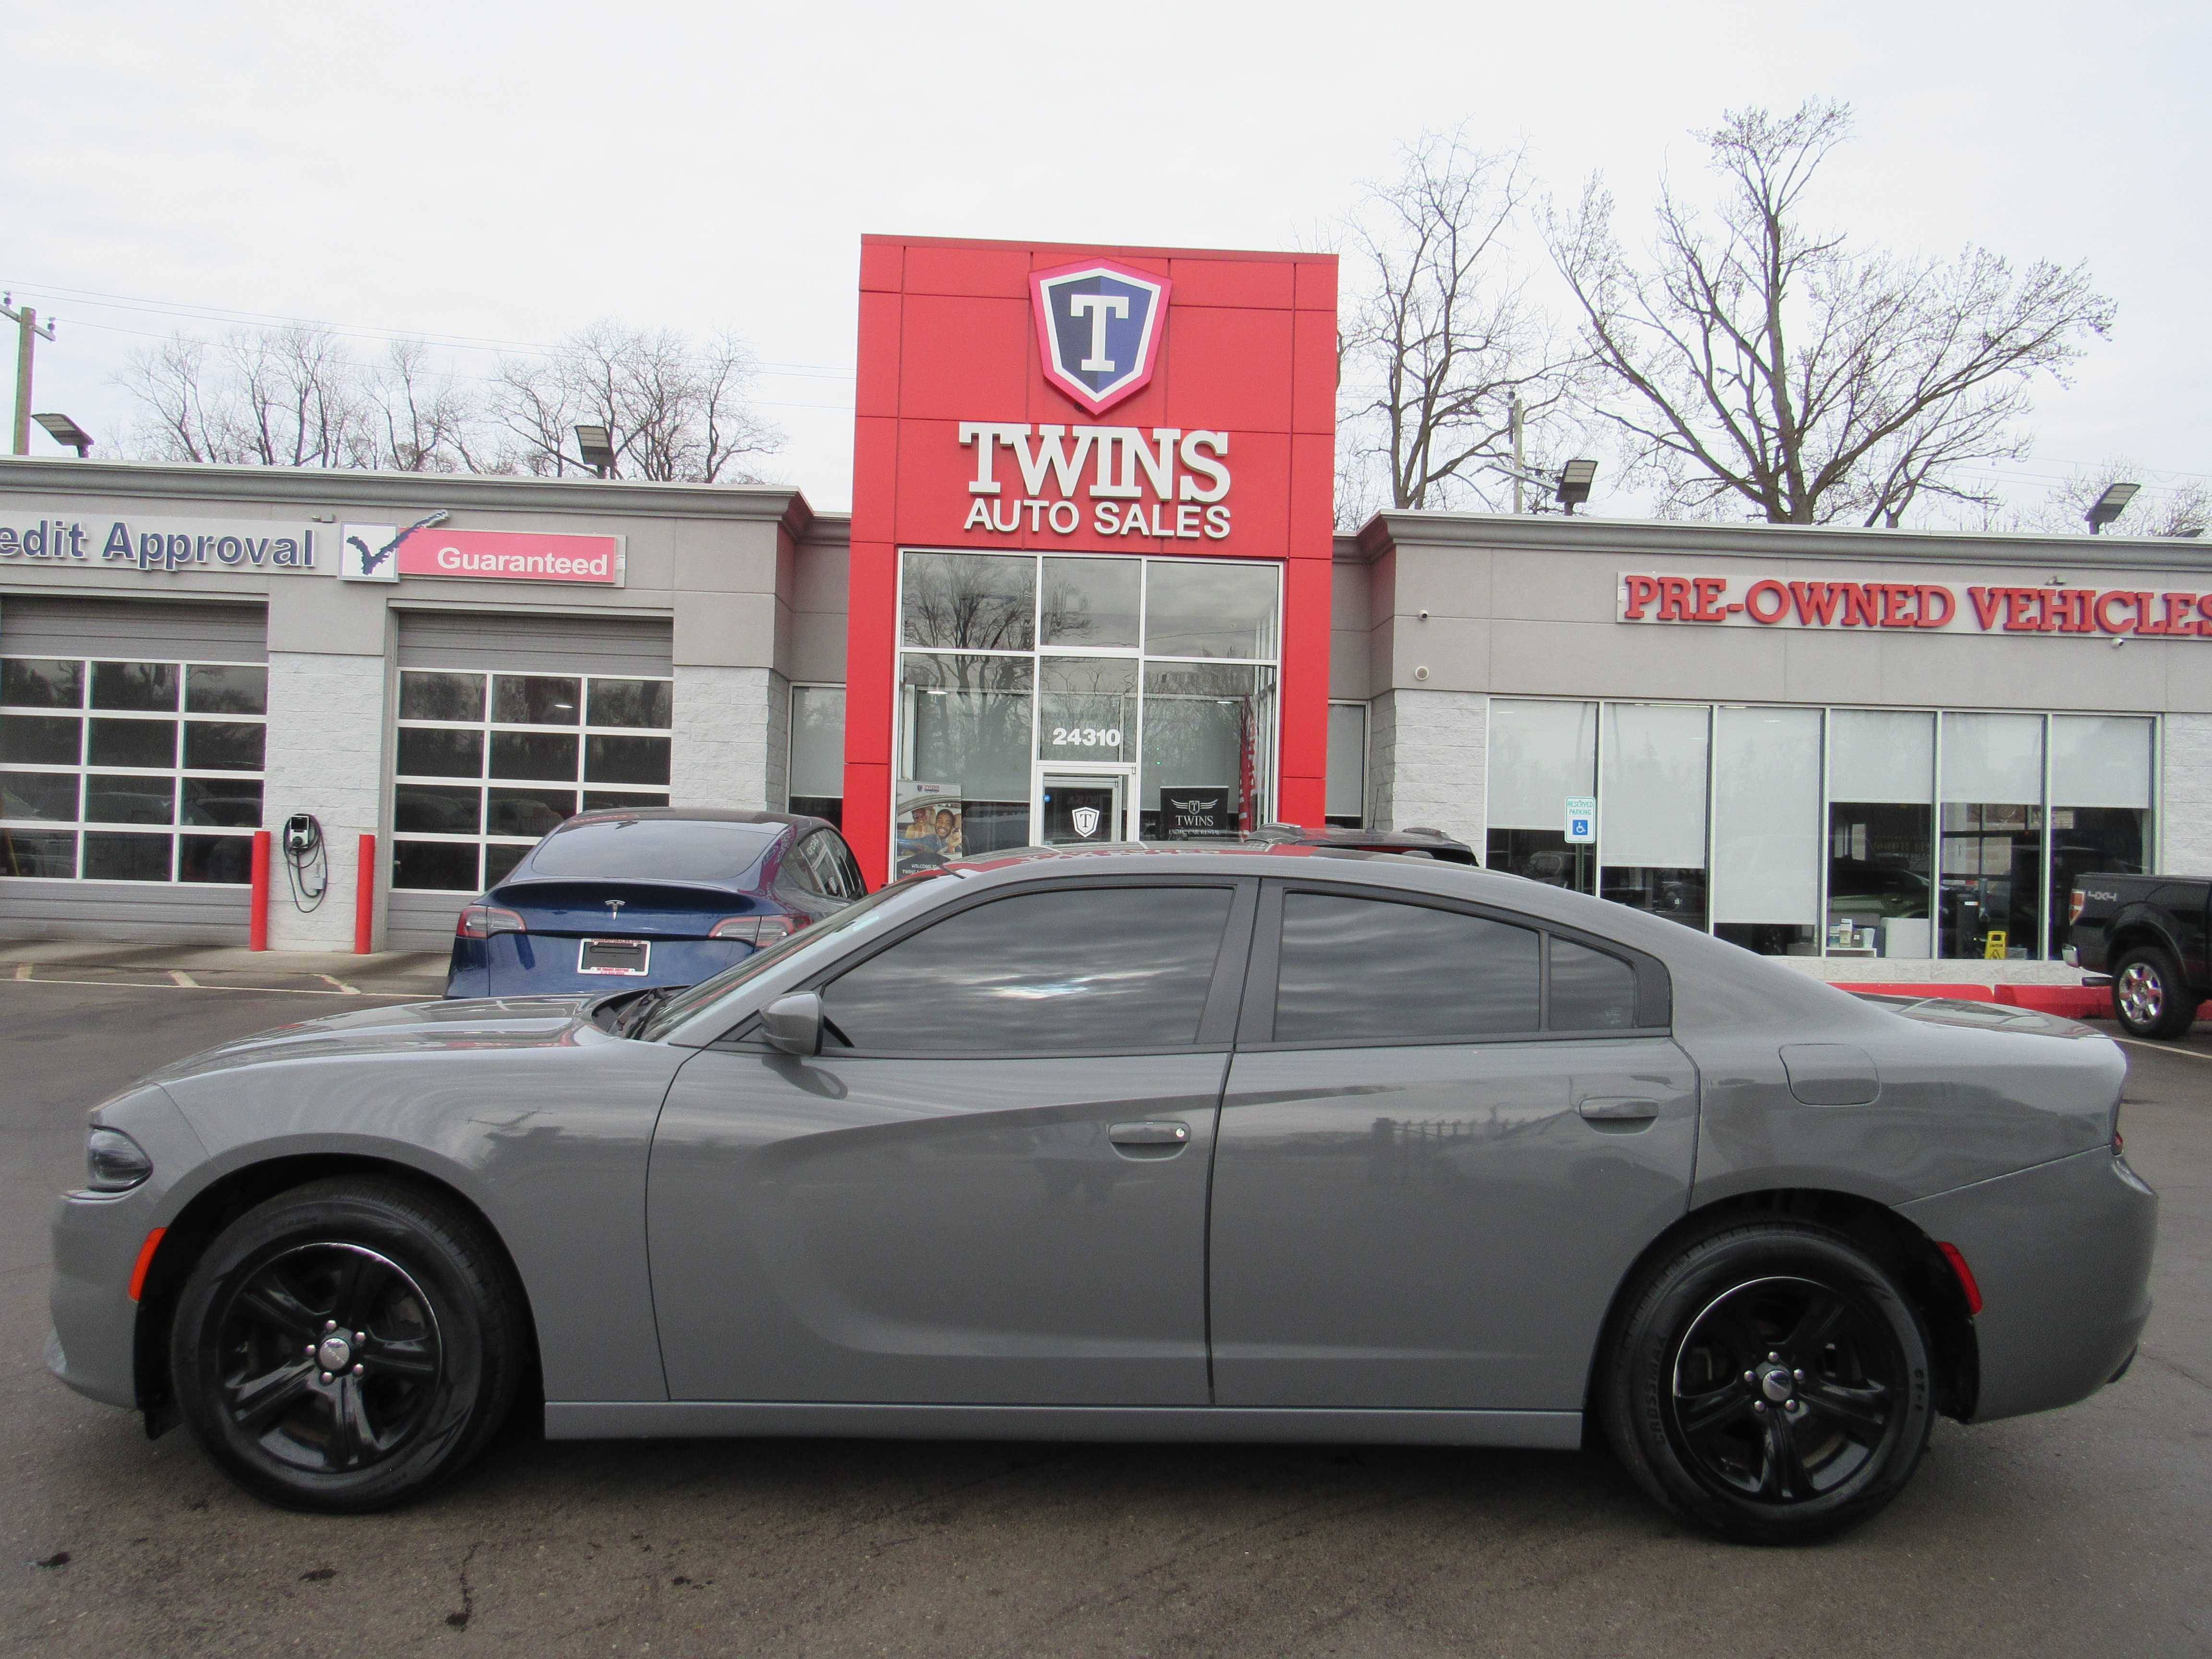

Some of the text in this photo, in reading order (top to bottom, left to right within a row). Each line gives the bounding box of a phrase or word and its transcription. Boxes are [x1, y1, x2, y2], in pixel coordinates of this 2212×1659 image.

[1070, 294, 1129, 372] T
[959, 421, 1230, 503] TWINS
[964, 498, 1231, 539] AUTO SALES
[0, 519, 315, 572] edit Approval
[437, 547, 608, 575] Guaranteed
[1625, 575, 1956, 627] PRE-OWNED
[1053, 728, 1120, 746] 24310
[1080, 814, 1092, 828] T
[1175, 815, 1214, 826] TWINS
